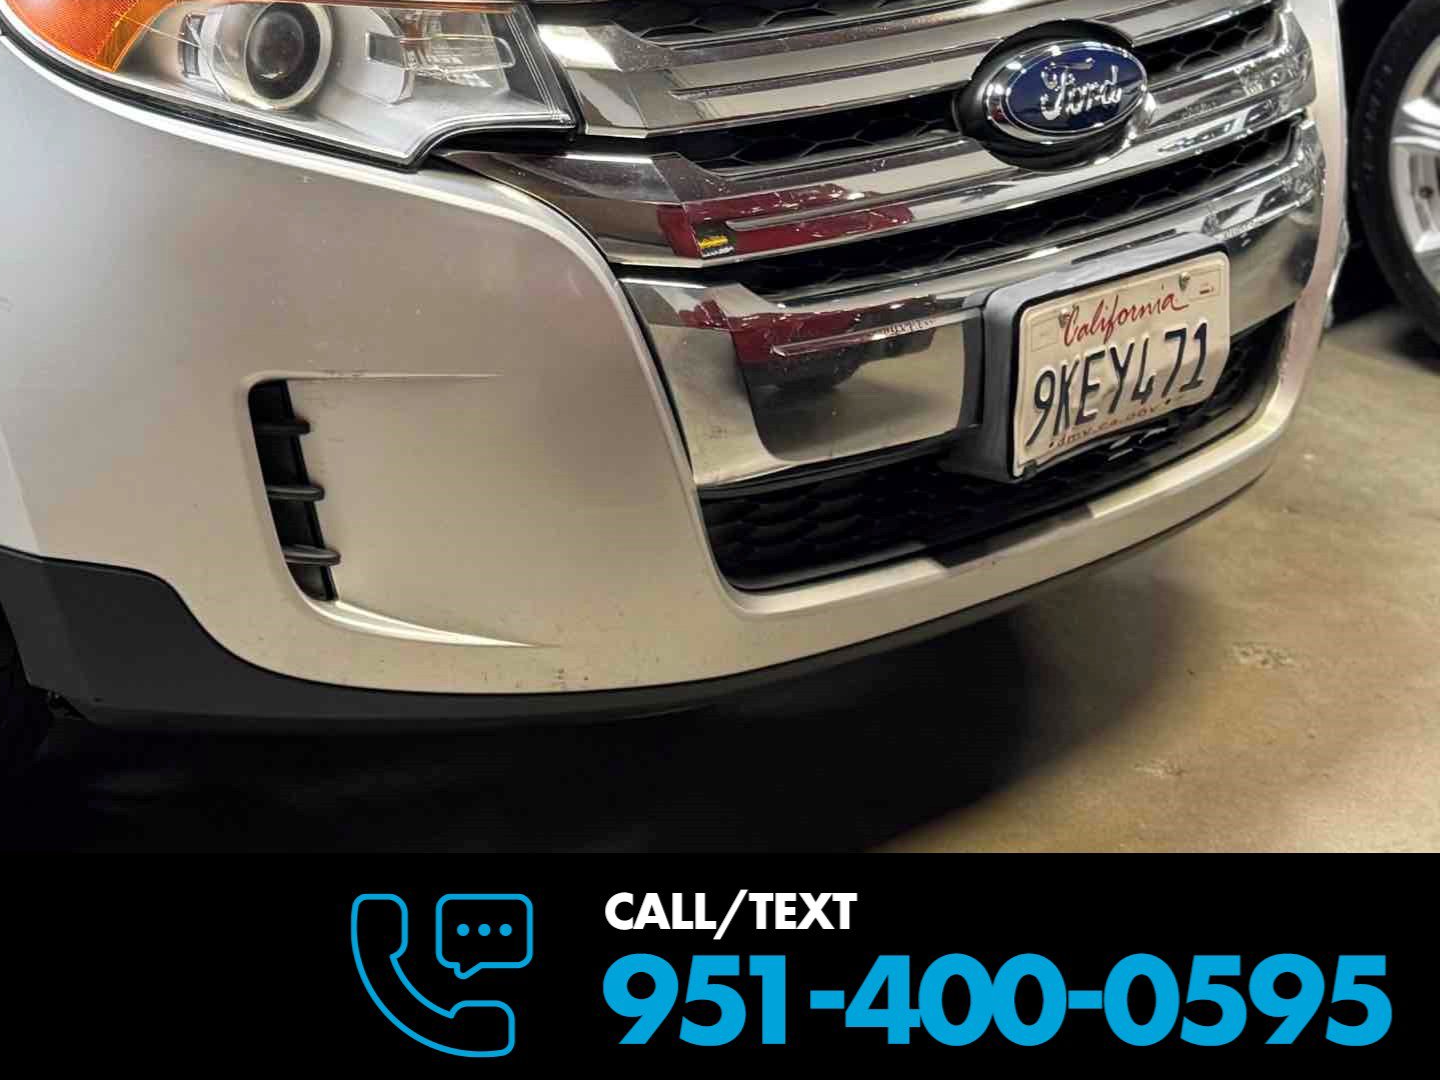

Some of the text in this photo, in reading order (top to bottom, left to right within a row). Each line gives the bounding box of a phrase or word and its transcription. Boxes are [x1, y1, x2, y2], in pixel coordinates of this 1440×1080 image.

[1040, 58, 1122, 121] Ford
[1063, 285, 1190, 348] California
[1025, 322, 1209, 448] 9KEY471
